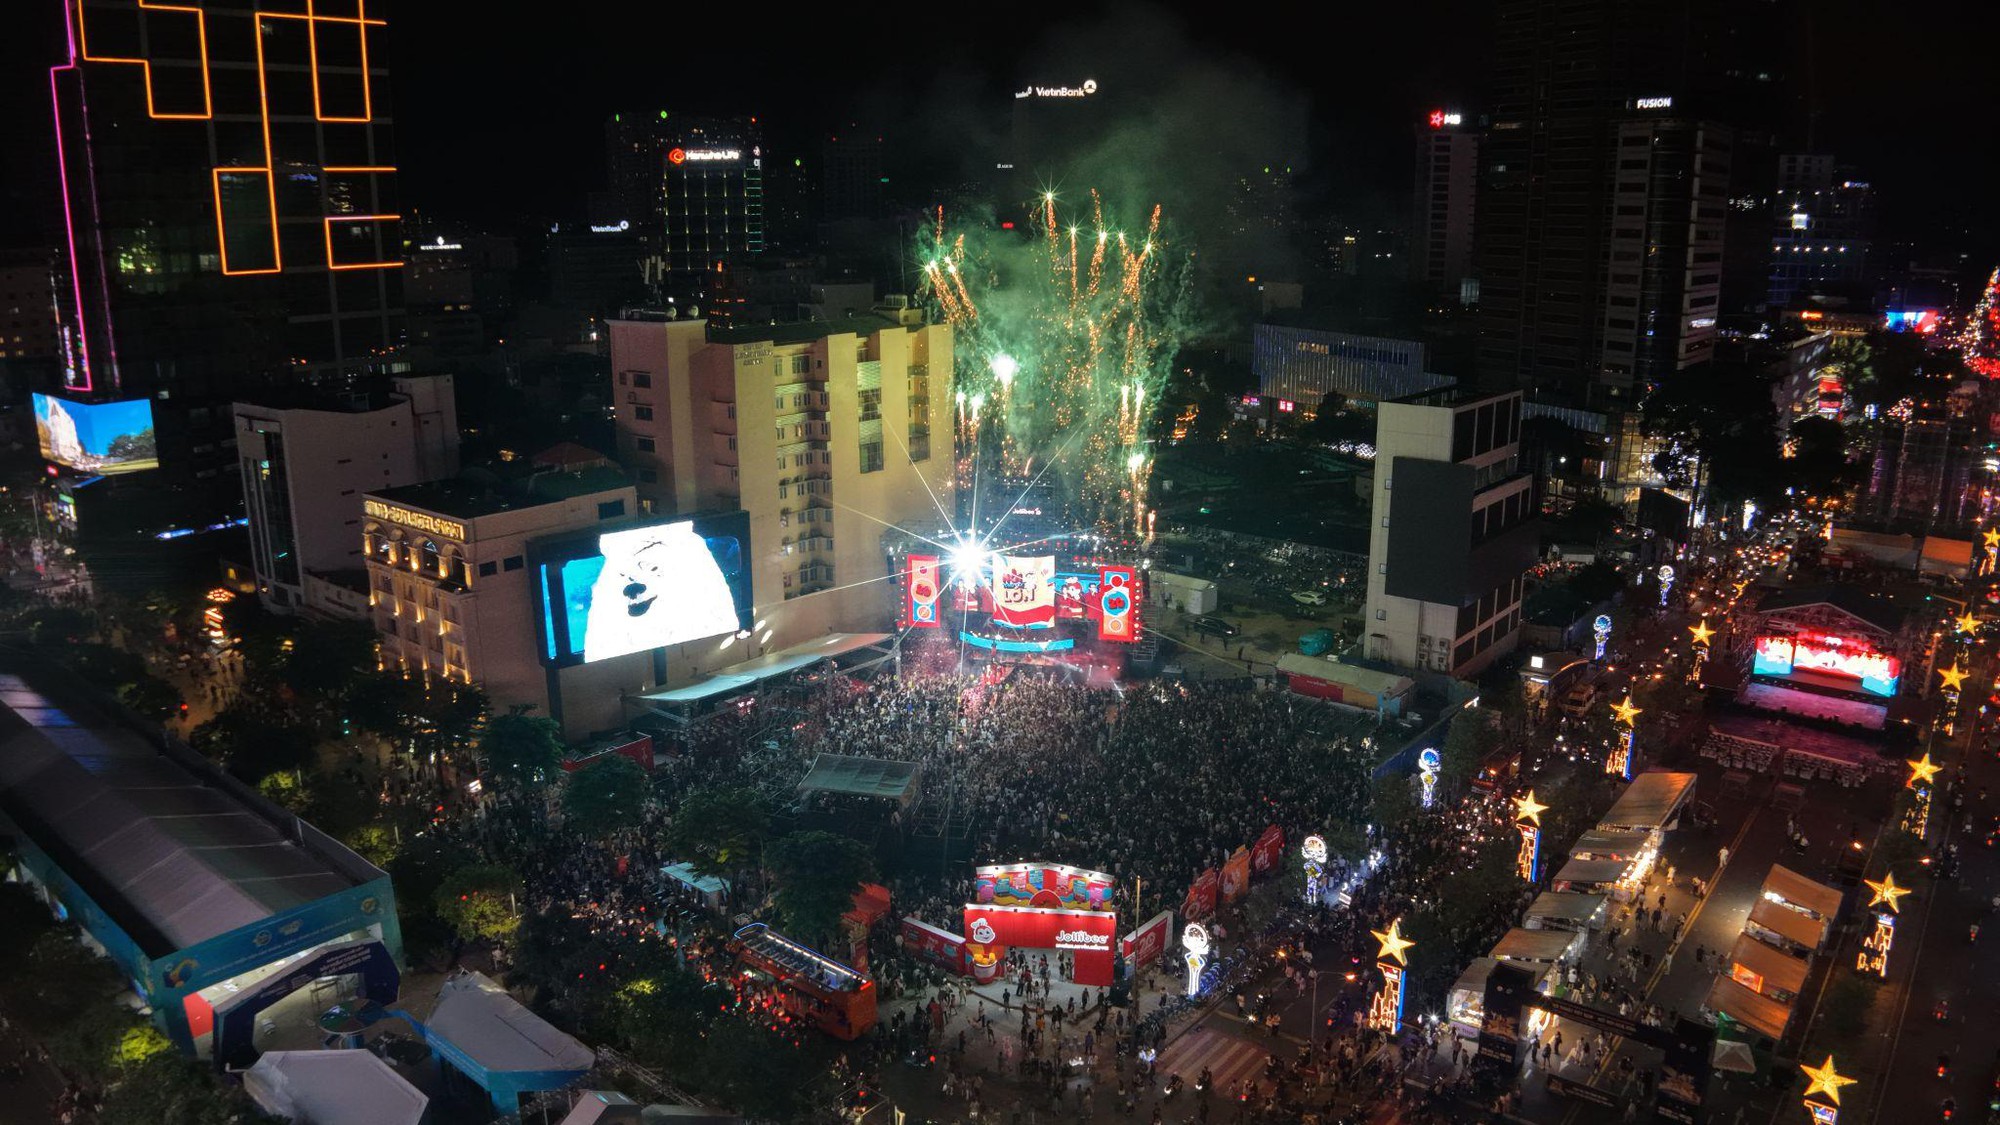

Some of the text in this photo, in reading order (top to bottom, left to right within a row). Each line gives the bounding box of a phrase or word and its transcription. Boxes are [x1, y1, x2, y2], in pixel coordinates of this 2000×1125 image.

[1035, 86, 1085, 97] VietinBank
[1636, 97, 1672, 109] FUSION
[1055, 929, 1109, 944] Jollibee
